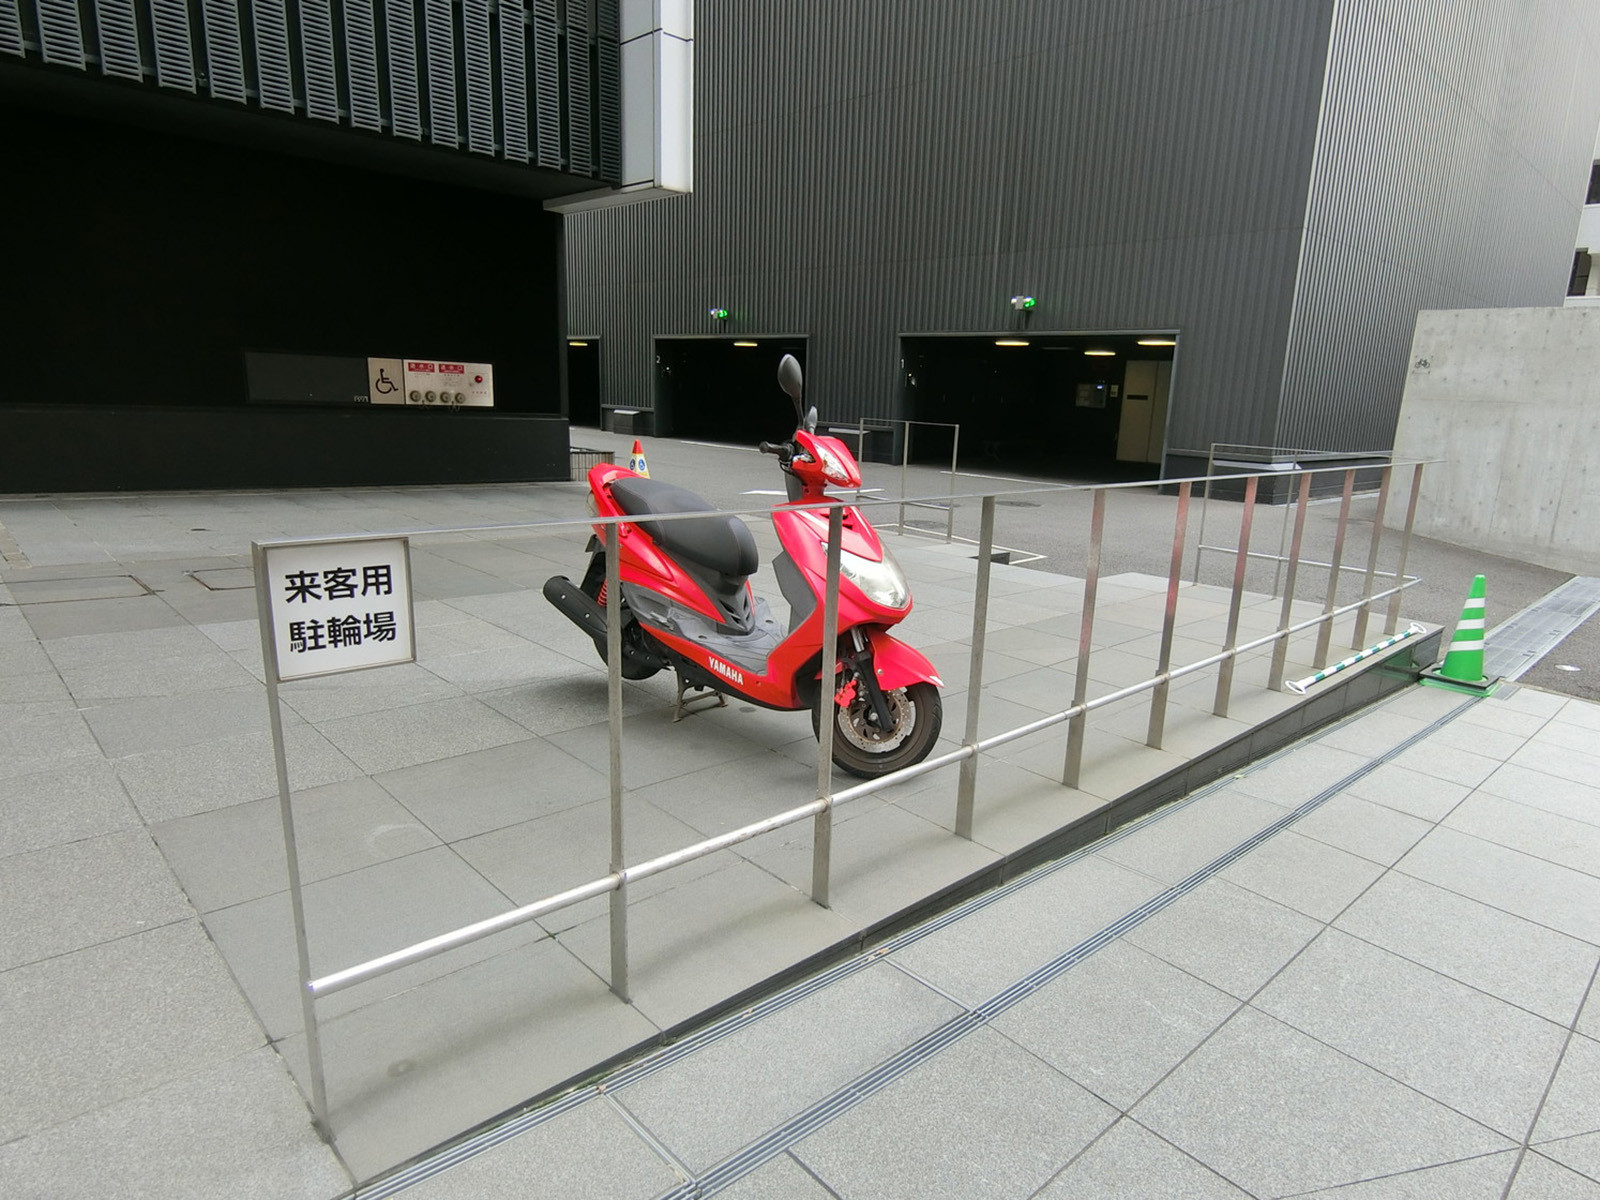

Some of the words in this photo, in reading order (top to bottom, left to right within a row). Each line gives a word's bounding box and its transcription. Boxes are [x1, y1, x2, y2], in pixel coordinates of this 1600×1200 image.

[284, 564, 393, 604] 来客用
[289, 611, 397, 653] 駐輪場
[708, 656, 744, 686] YAMAHA
